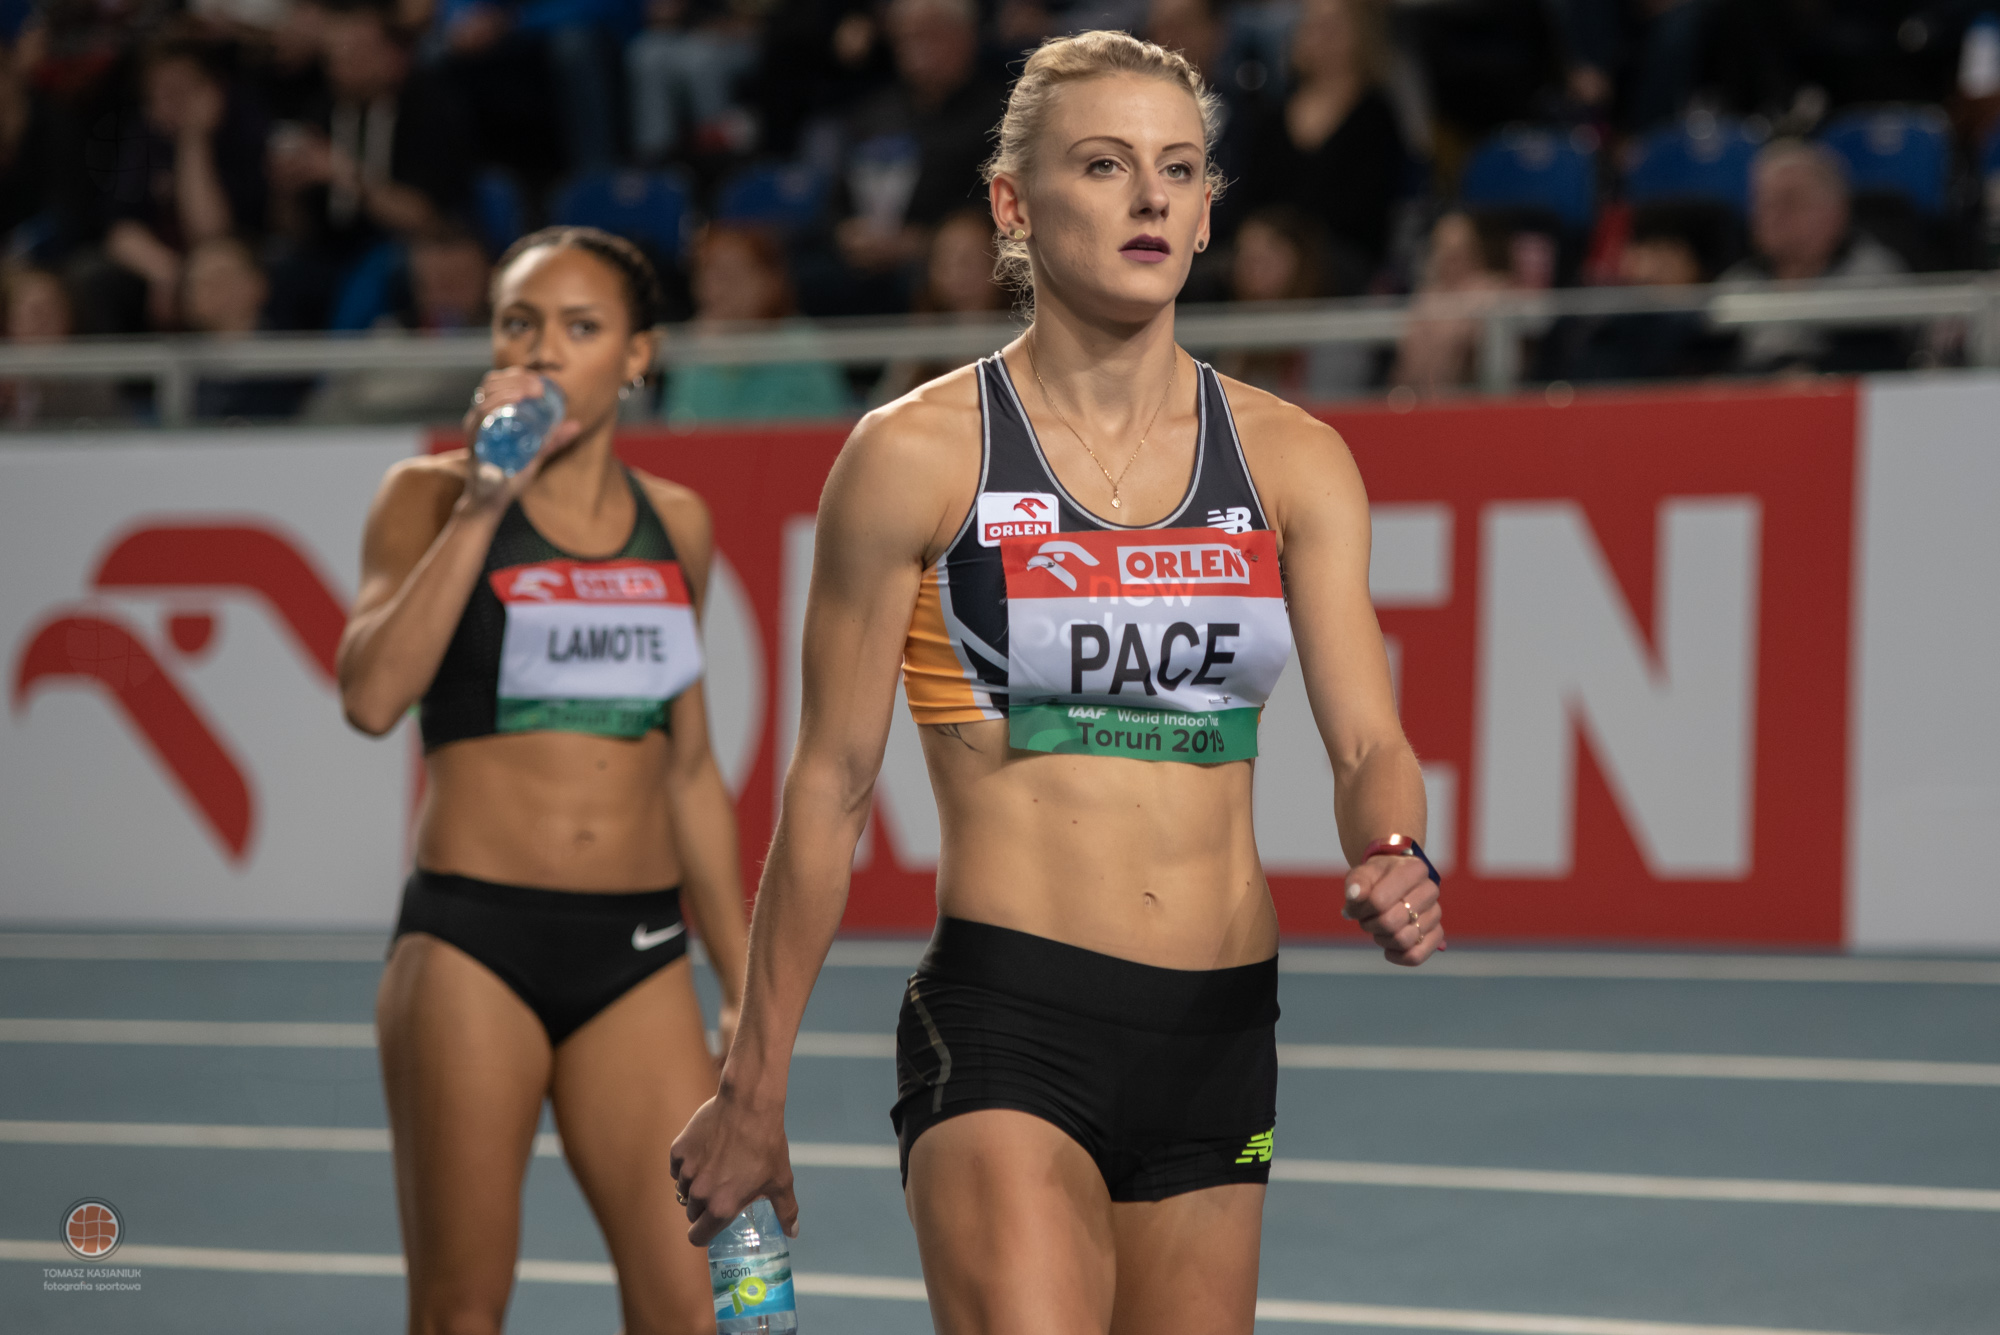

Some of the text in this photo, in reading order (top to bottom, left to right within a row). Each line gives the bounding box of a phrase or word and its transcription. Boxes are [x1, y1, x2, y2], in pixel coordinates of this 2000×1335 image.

[989, 523, 1048, 539] ORLEN
[1125, 549, 1246, 580] ORLEN
[546, 624, 666, 664] LAMOTE
[1070, 621, 1241, 697] PACE
[1068, 706, 1109, 720] IAAF
[1117, 709, 1160, 725] World
[1164, 711, 1208, 728] Indoor
[1077, 721, 1225, 754] Toruń 2019
[721, 1267, 751, 1279] WODA
